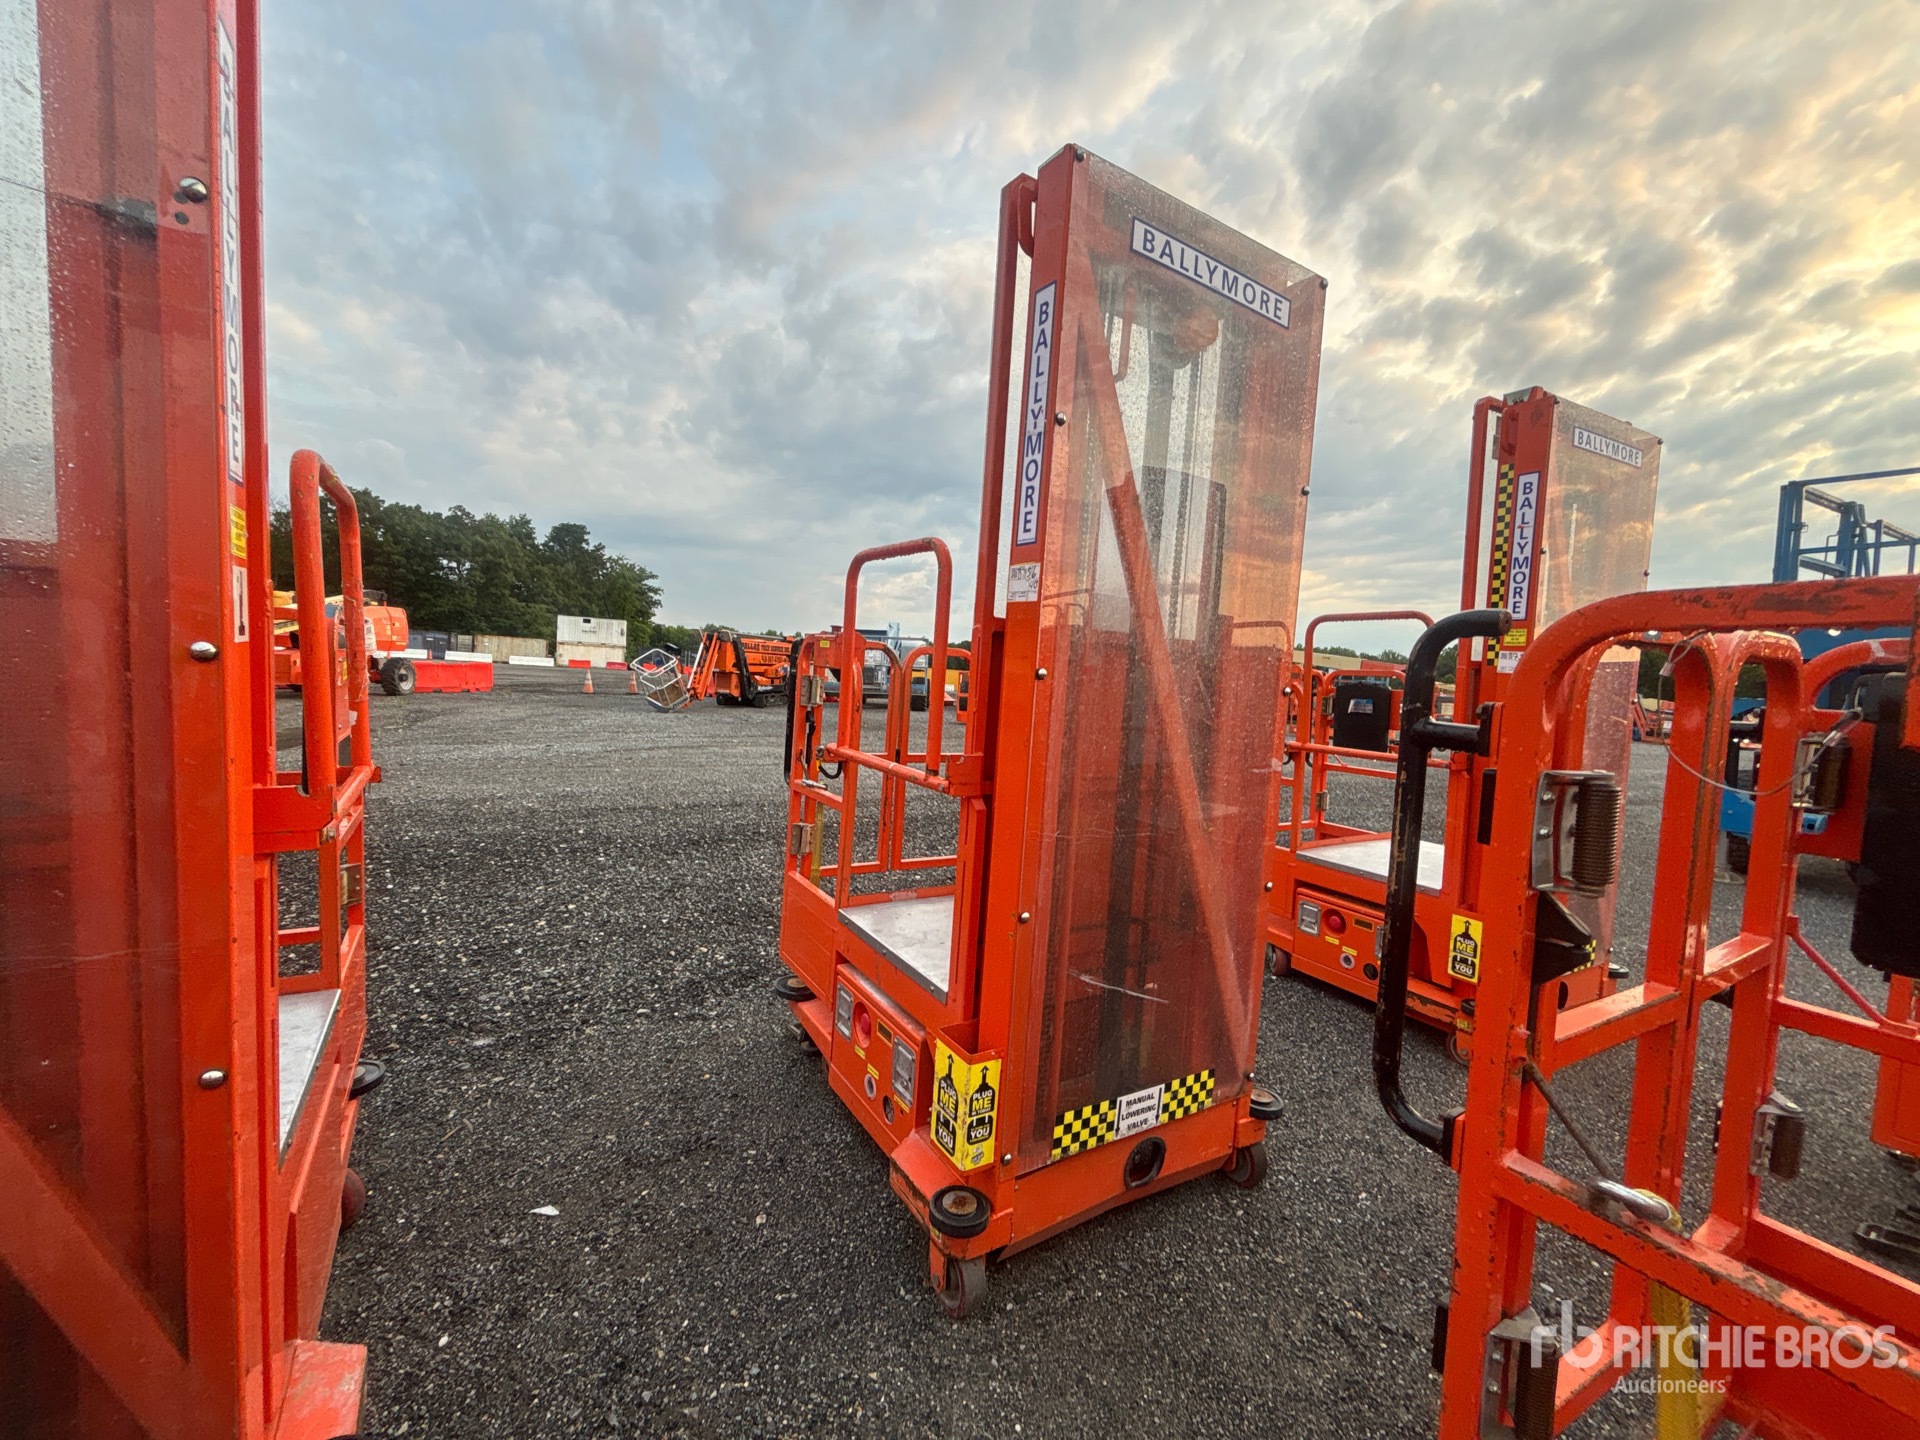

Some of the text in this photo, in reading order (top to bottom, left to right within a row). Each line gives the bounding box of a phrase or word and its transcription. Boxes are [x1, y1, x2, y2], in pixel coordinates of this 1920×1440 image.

[221, 53, 240, 464] BALLYMORE
[1142, 227, 1283, 321] BALLYMORE
[1022, 301, 1050, 534] BALLYMORE
[1577, 431, 1641, 465] BALLYMORE
[1511, 481, 1533, 614] BALLYMORE
[1456, 936, 1475, 947] PLUG
[1456, 941, 1475, 954] ME
[1454, 963, 1473, 975] YOU
[940, 1079, 957, 1100] PLUG
[972, 1089, 993, 1101] PLUG
[939, 1088, 956, 1114] ME
[972, 1096, 992, 1112] ME
[1125, 1092, 1155, 1108] MANUAL
[1121, 1103, 1157, 1121] LOWERING
[970, 1126, 990, 1139] YOU
[1126, 1118, 1149, 1131] VALVE
[937, 1125, 954, 1149] YOU
